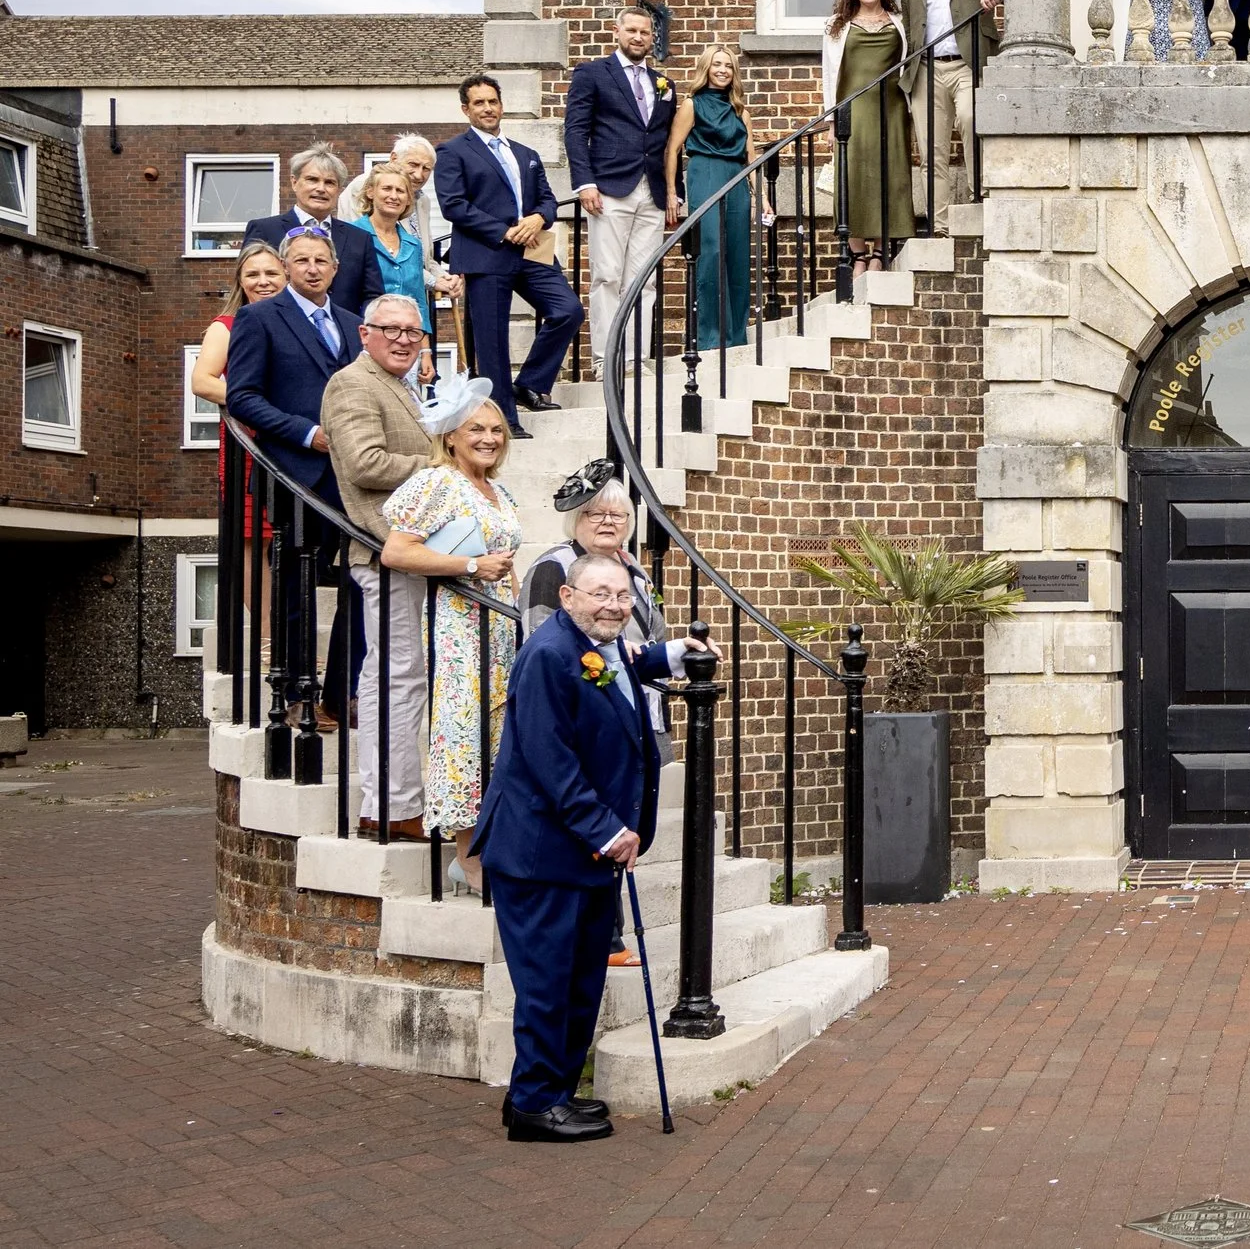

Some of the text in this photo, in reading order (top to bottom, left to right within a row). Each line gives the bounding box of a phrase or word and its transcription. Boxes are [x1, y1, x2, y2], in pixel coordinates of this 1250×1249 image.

[1149, 381, 1183, 432] Poole
[1175, 318, 1246, 378] Register
[1038, 574, 1059, 582] Register
